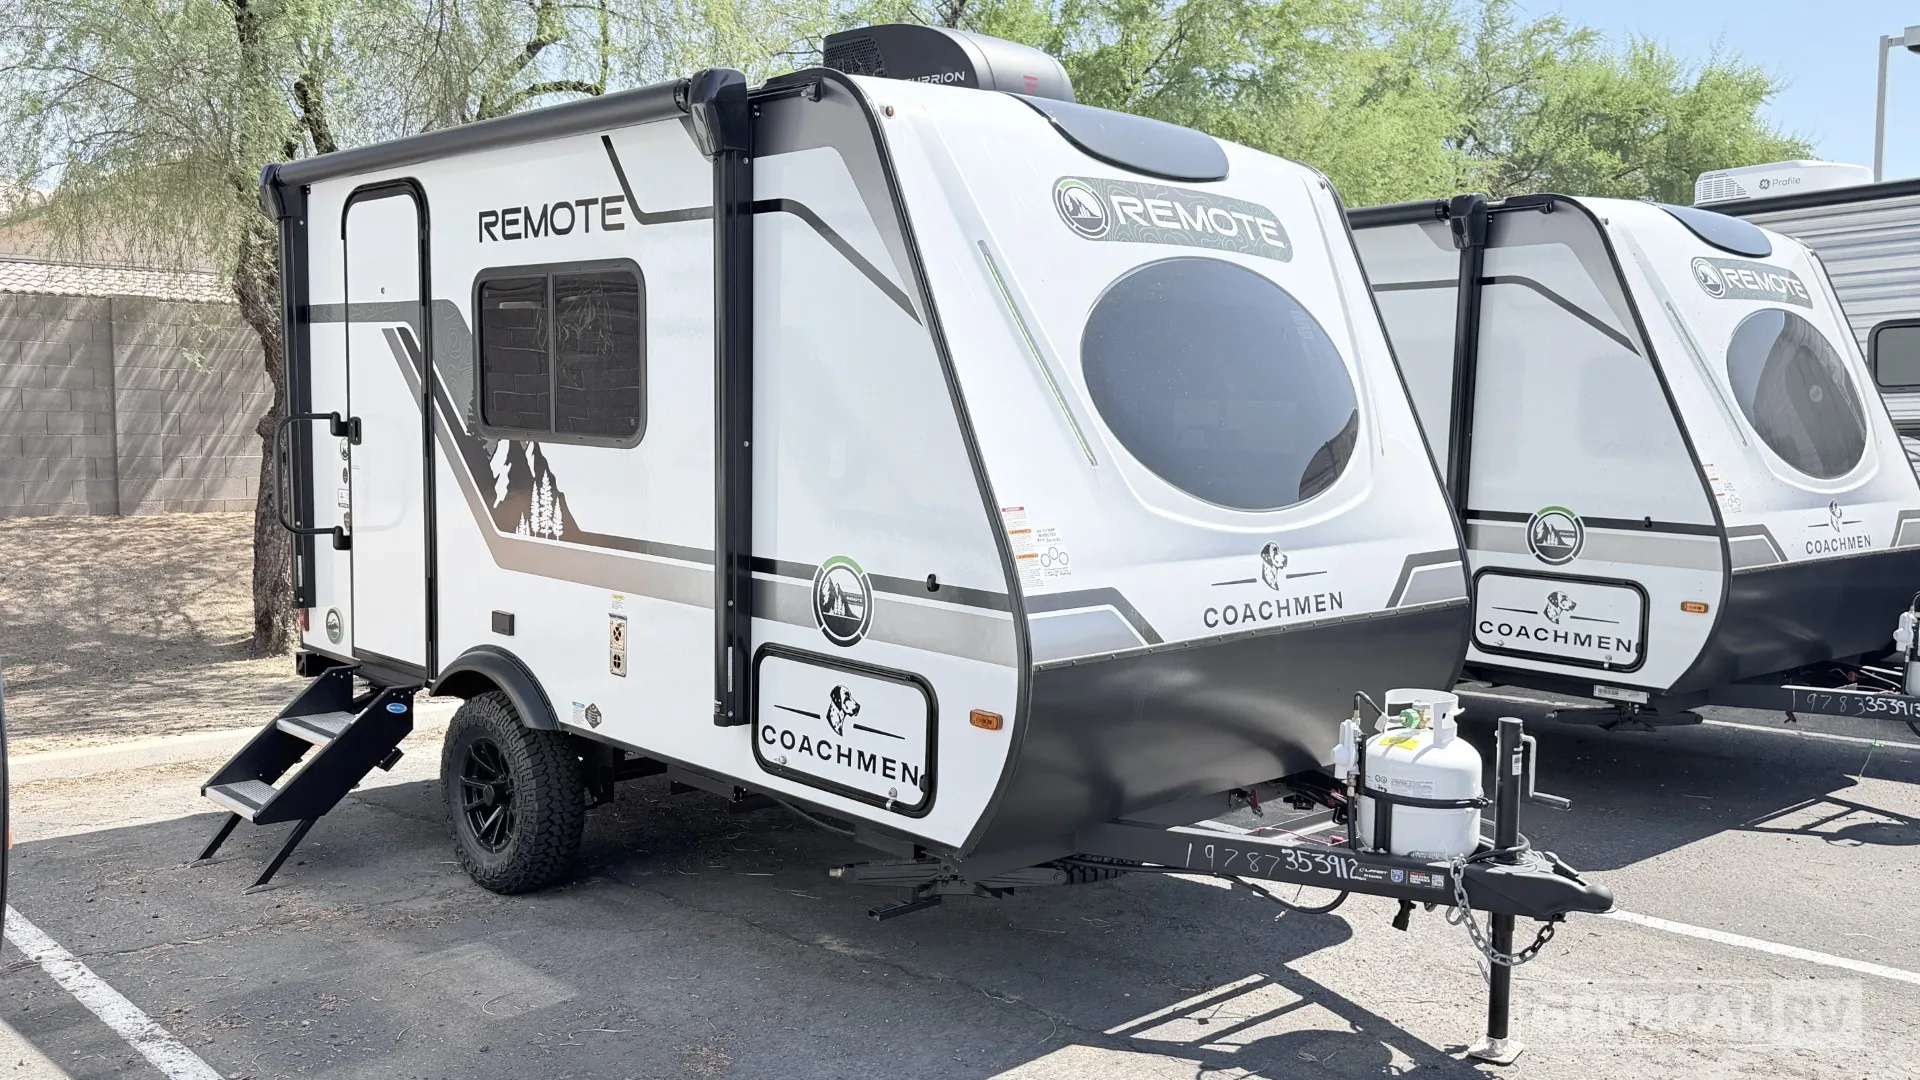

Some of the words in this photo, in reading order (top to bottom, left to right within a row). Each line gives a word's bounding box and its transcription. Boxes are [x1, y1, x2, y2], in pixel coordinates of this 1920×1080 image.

[904, 71, 965, 84] URRION
[1772, 176, 1801, 188] Profile
[479, 195, 625, 243] REMOTE
[1109, 195, 1285, 248] REMOTE
[1720, 268, 1809, 298] REMOTE
[1805, 535, 1872, 555] COACHMEN
[1203, 591, 1343, 628] COACHMEN
[1479, 620, 1632, 653] COACHMEN
[761, 724, 919, 787] COACHMEN
